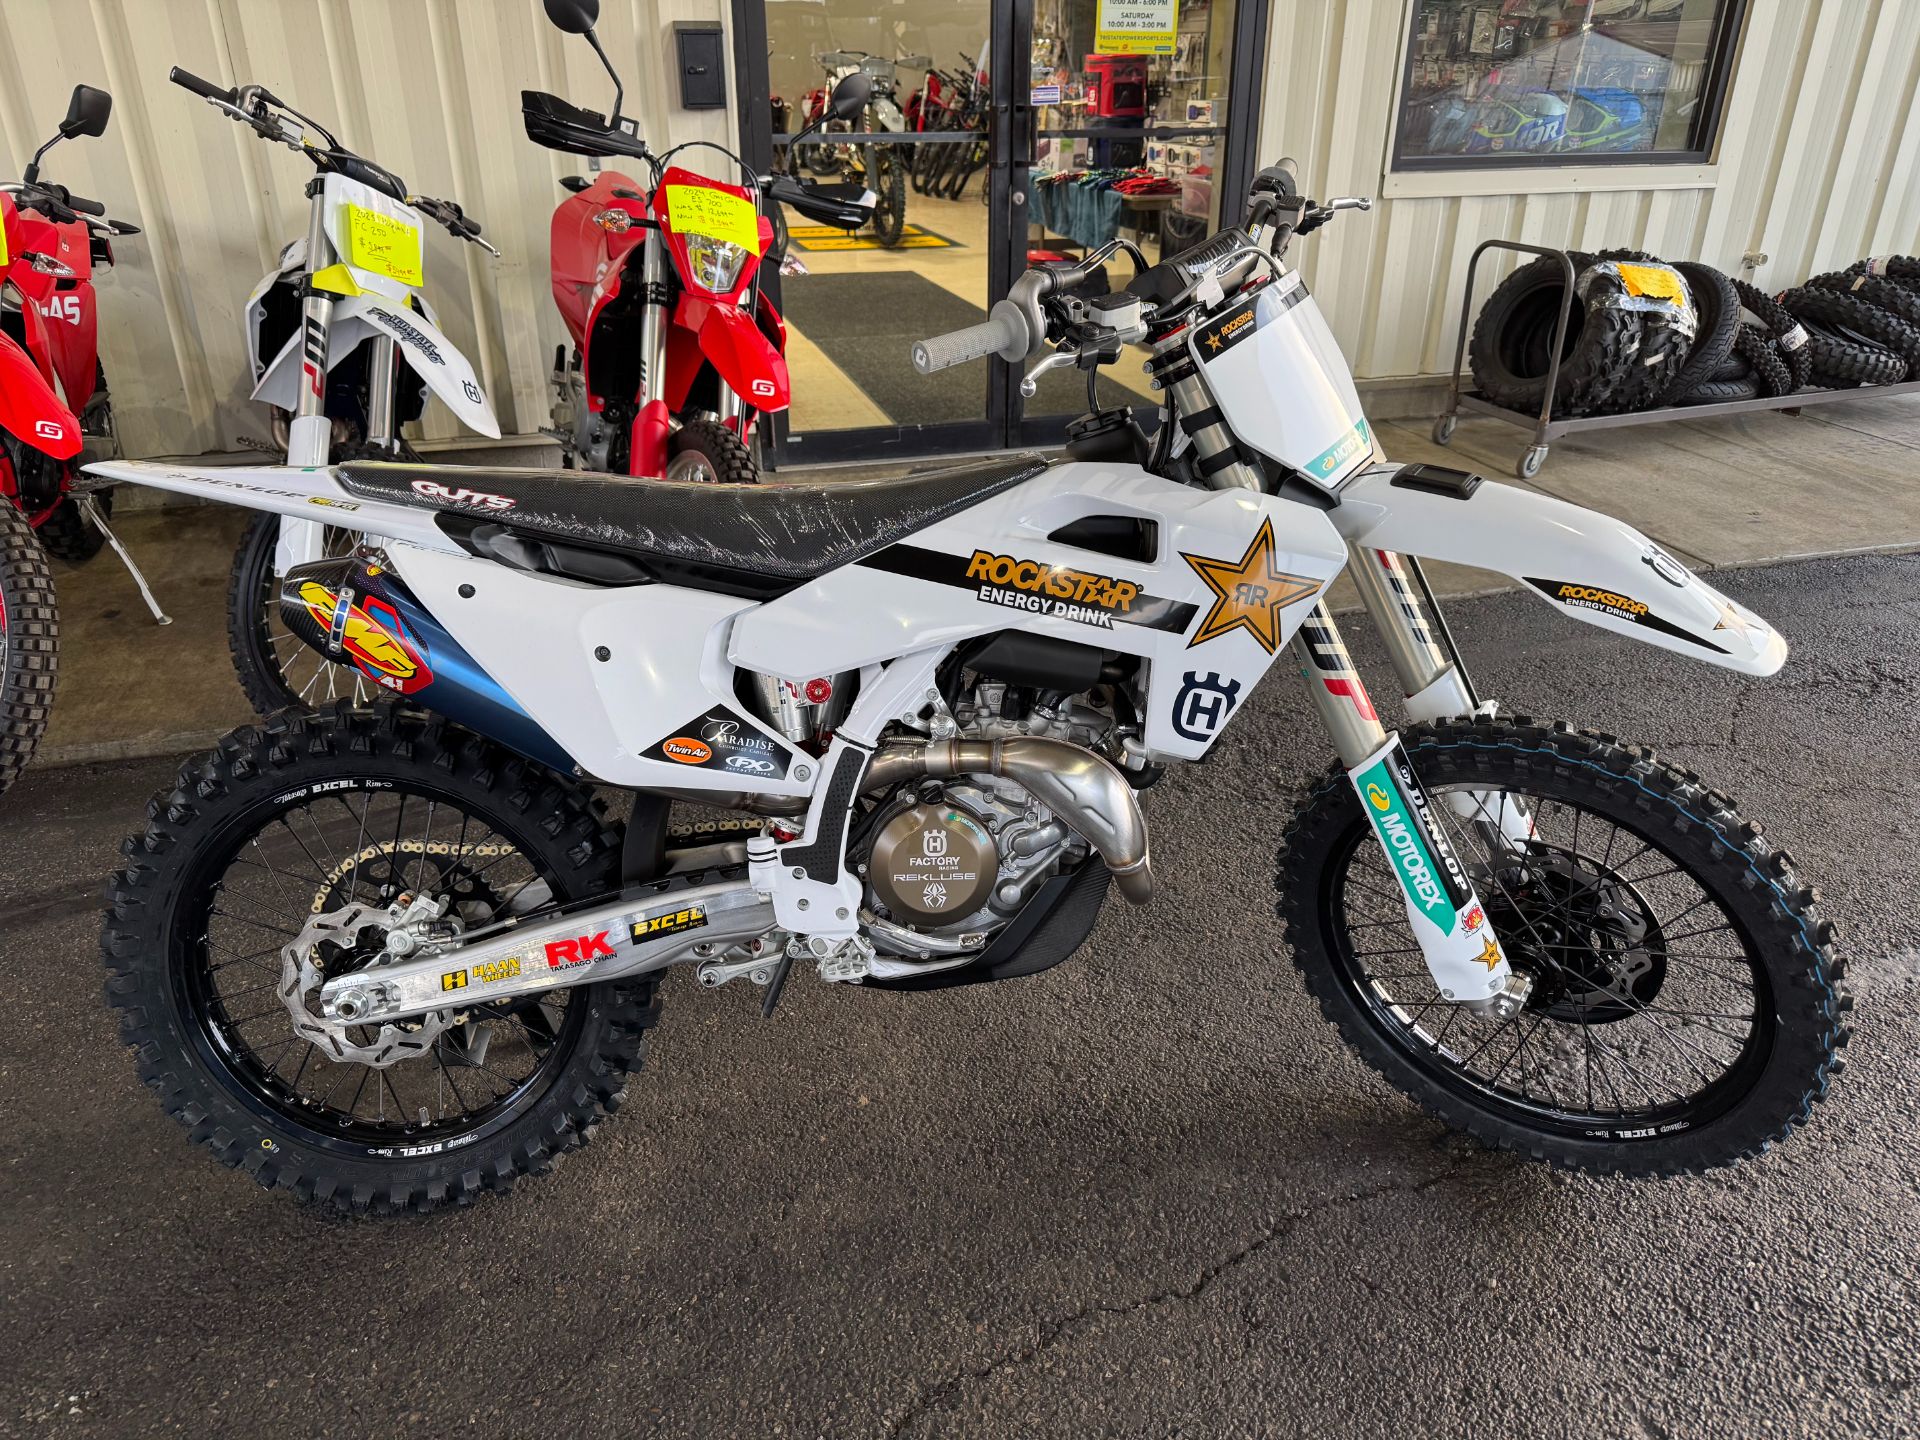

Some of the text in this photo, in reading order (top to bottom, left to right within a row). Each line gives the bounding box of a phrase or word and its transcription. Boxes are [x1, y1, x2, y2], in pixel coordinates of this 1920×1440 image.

[706, 198, 722, 208] 700
[371, 226, 387, 237] 250
[1220, 310, 1255, 337] ROCKSTAR
[411, 479, 517, 509] GUTS
[966, 550, 1138, 612] ROCKSTAR
[979, 585, 1113, 628] ENERGY DRINK
[1558, 585, 1648, 616] ROCKSTAR
[1566, 598, 1637, 621] ENERGY DRINK
[701, 715, 775, 752] PARADISE
[668, 743, 709, 757] Twin Air
[311, 780, 359, 794] EXCEL
[1407, 787, 1469, 891] DUNLOP
[909, 856, 961, 867] FACTORY
[1380, 812, 1446, 911] MOTOREX
[893, 872, 976, 882] REKLUSE
[633, 907, 704, 936] EXCEL
[544, 930, 616, 968] RK
[472, 956, 521, 978] HAAN
[550, 953, 618, 972] TAKASAGO CHAIN
[482, 967, 521, 984] WHEELS
[1615, 1127, 1658, 1139] EXCEL
[400, 1143, 443, 1157] EXCEL
